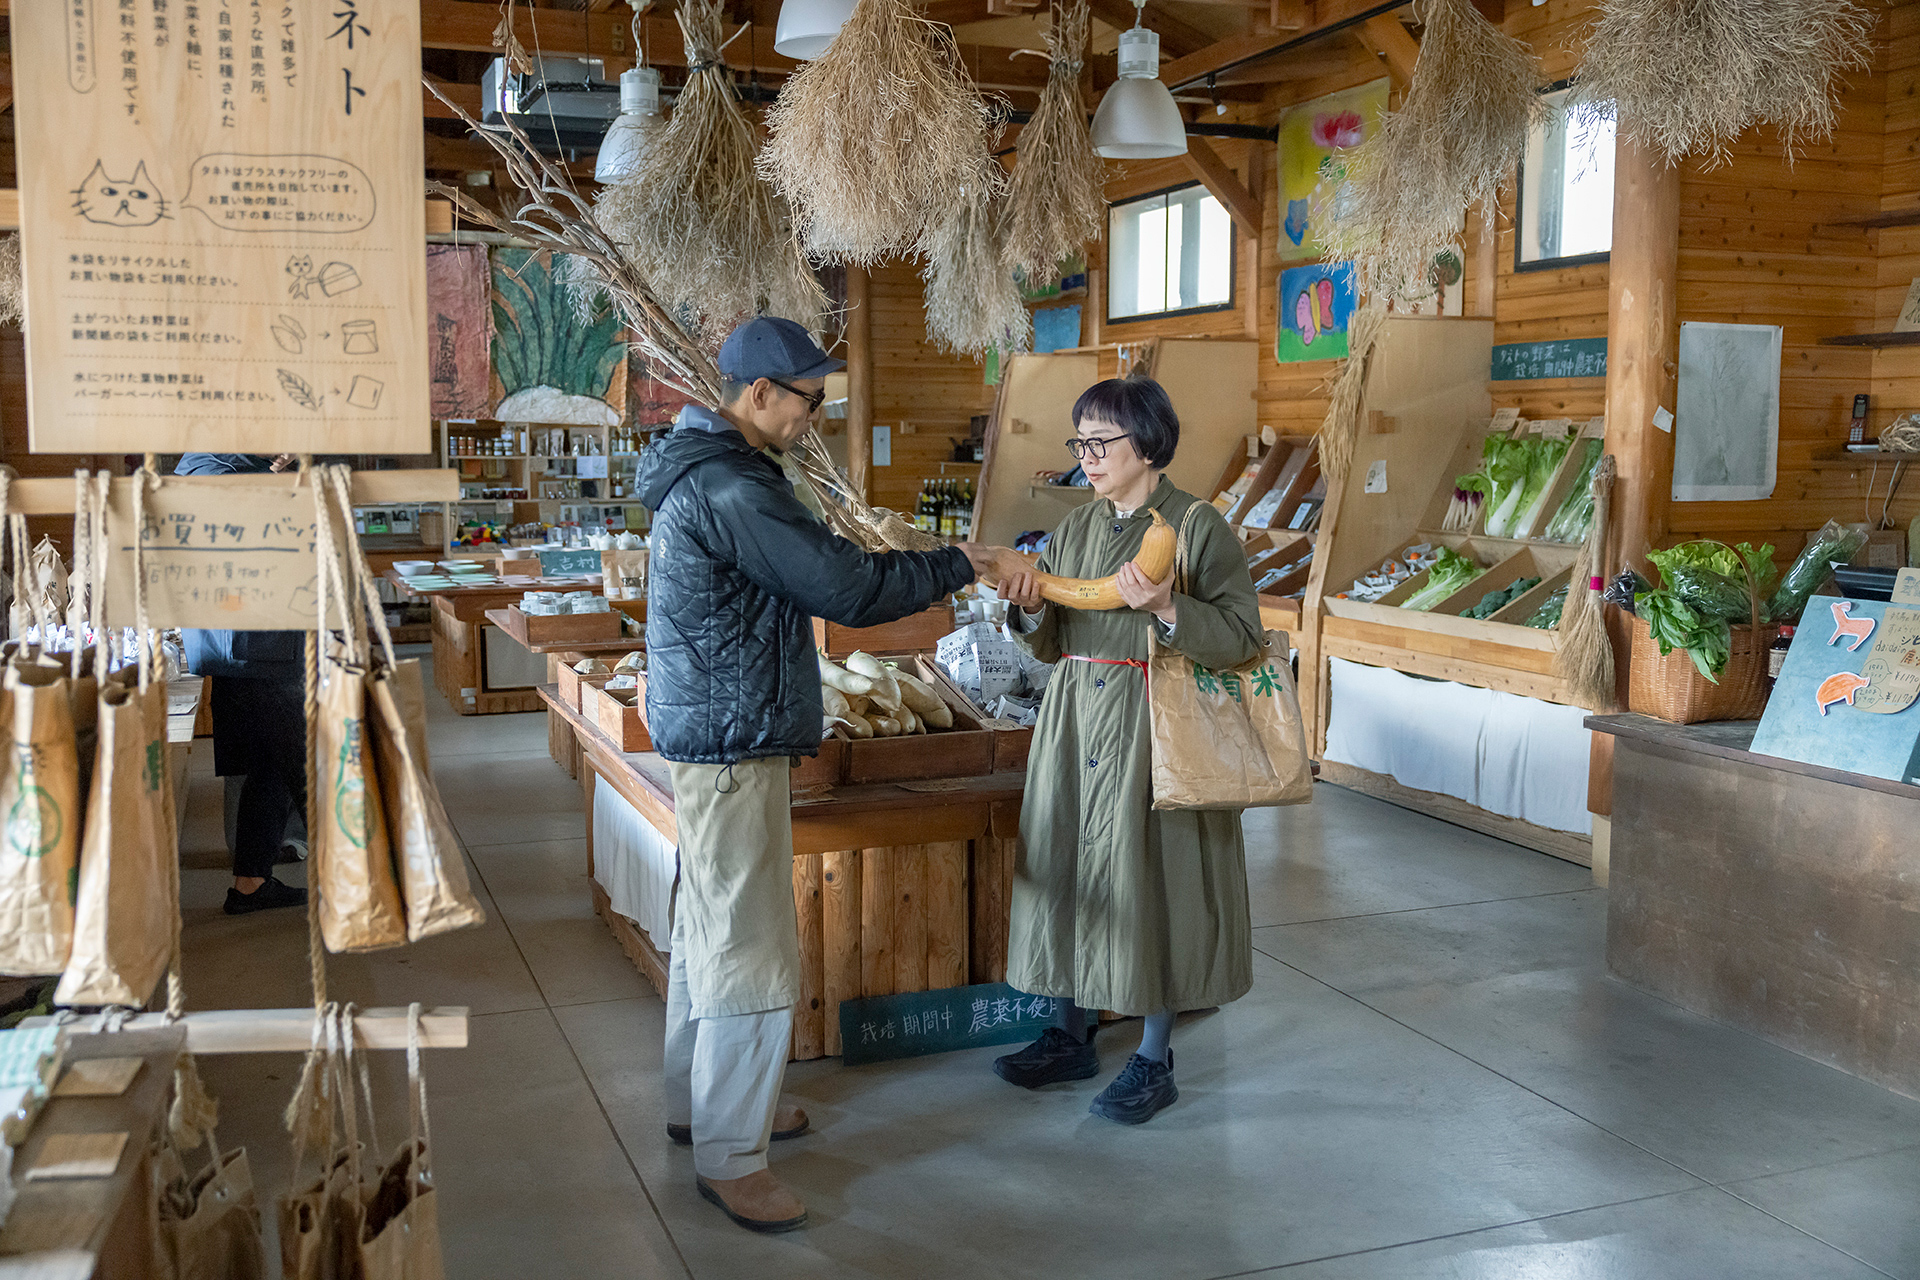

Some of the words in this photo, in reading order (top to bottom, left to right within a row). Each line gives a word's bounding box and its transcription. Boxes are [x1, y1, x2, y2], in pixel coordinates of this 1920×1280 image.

[185, 0, 203, 79] 菜を軸に、
[281, 0, 297, 88] クで雑多で
